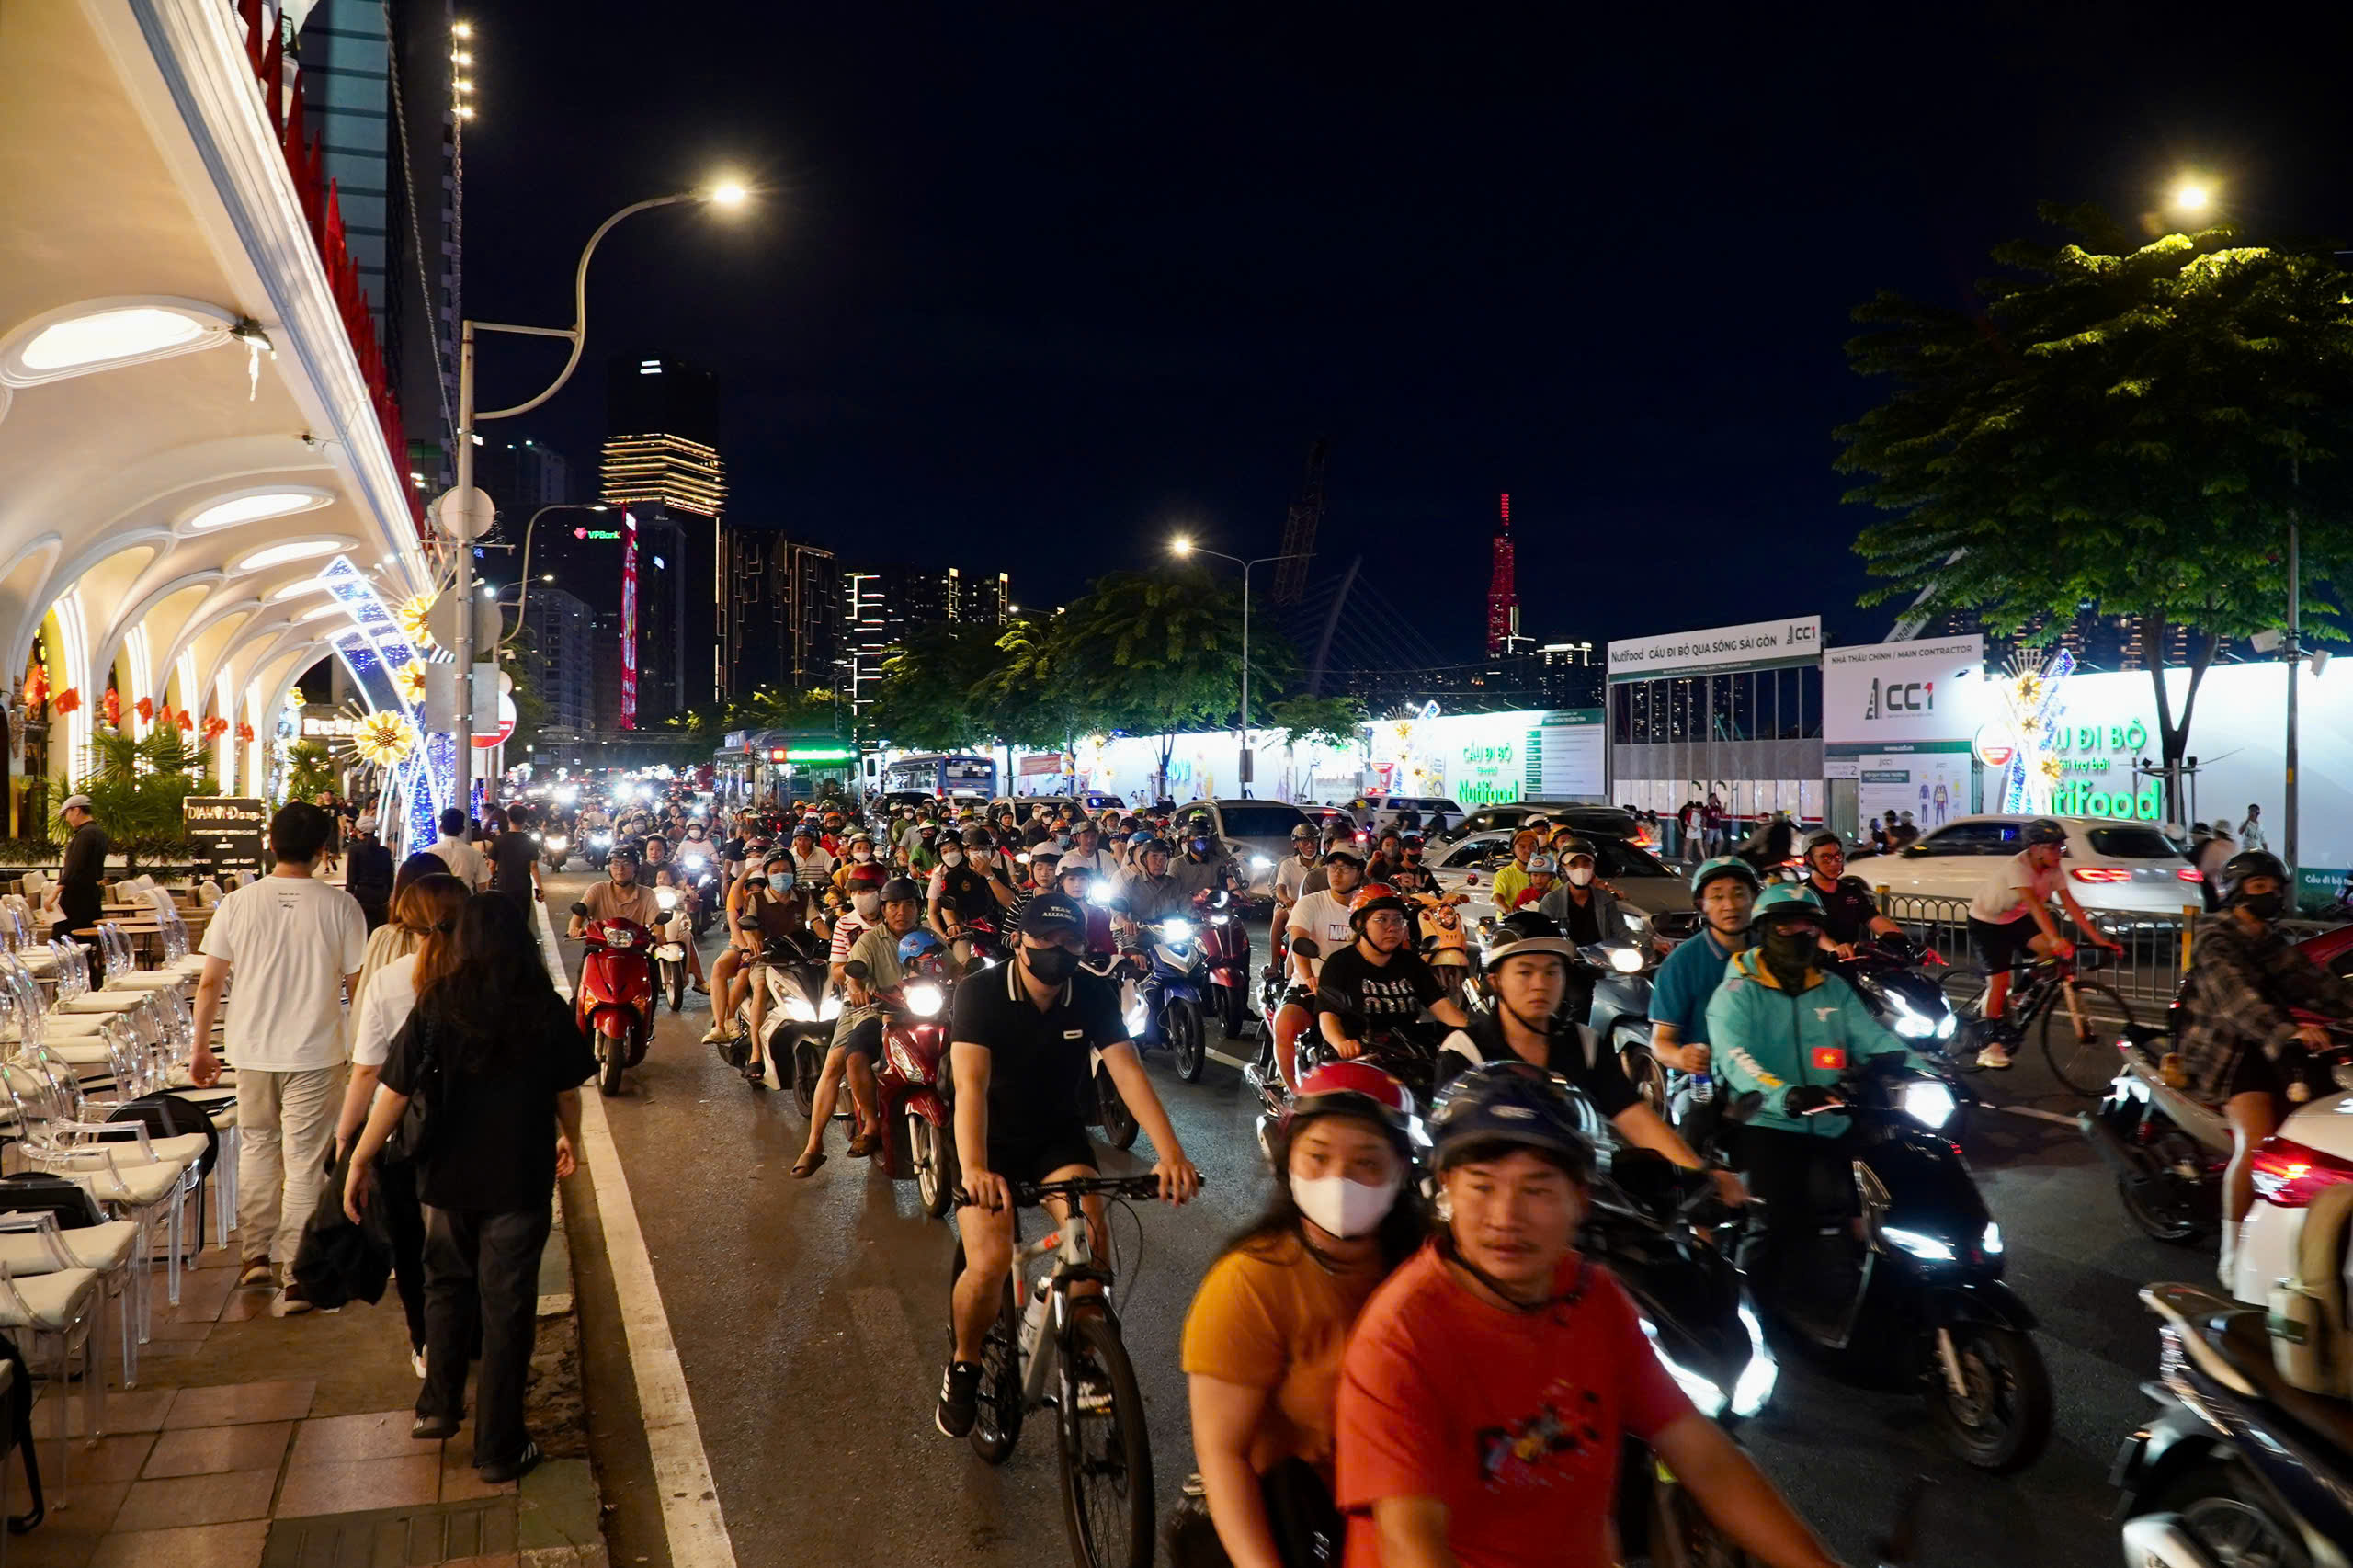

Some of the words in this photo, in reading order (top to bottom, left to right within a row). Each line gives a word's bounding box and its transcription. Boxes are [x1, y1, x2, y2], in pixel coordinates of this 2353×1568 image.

[588, 530, 621, 539] VPBank
[1795, 626, 1815, 642] CC1
[1611, 648, 1643, 664] Nutifood
[1691, 643, 1711, 656] QUA
[1739, 637, 1755, 650] SÀI
[1756, 634, 1778, 648] GÒN
[1919, 645, 1972, 657] CONTRACTOR
[1886, 681, 1934, 711] CC1
[2079, 725, 2102, 751] ĐI
[2110, 717, 2147, 756] BỘ
[1459, 779, 1518, 804] Nutifood
[2052, 779, 2161, 820] tifood
